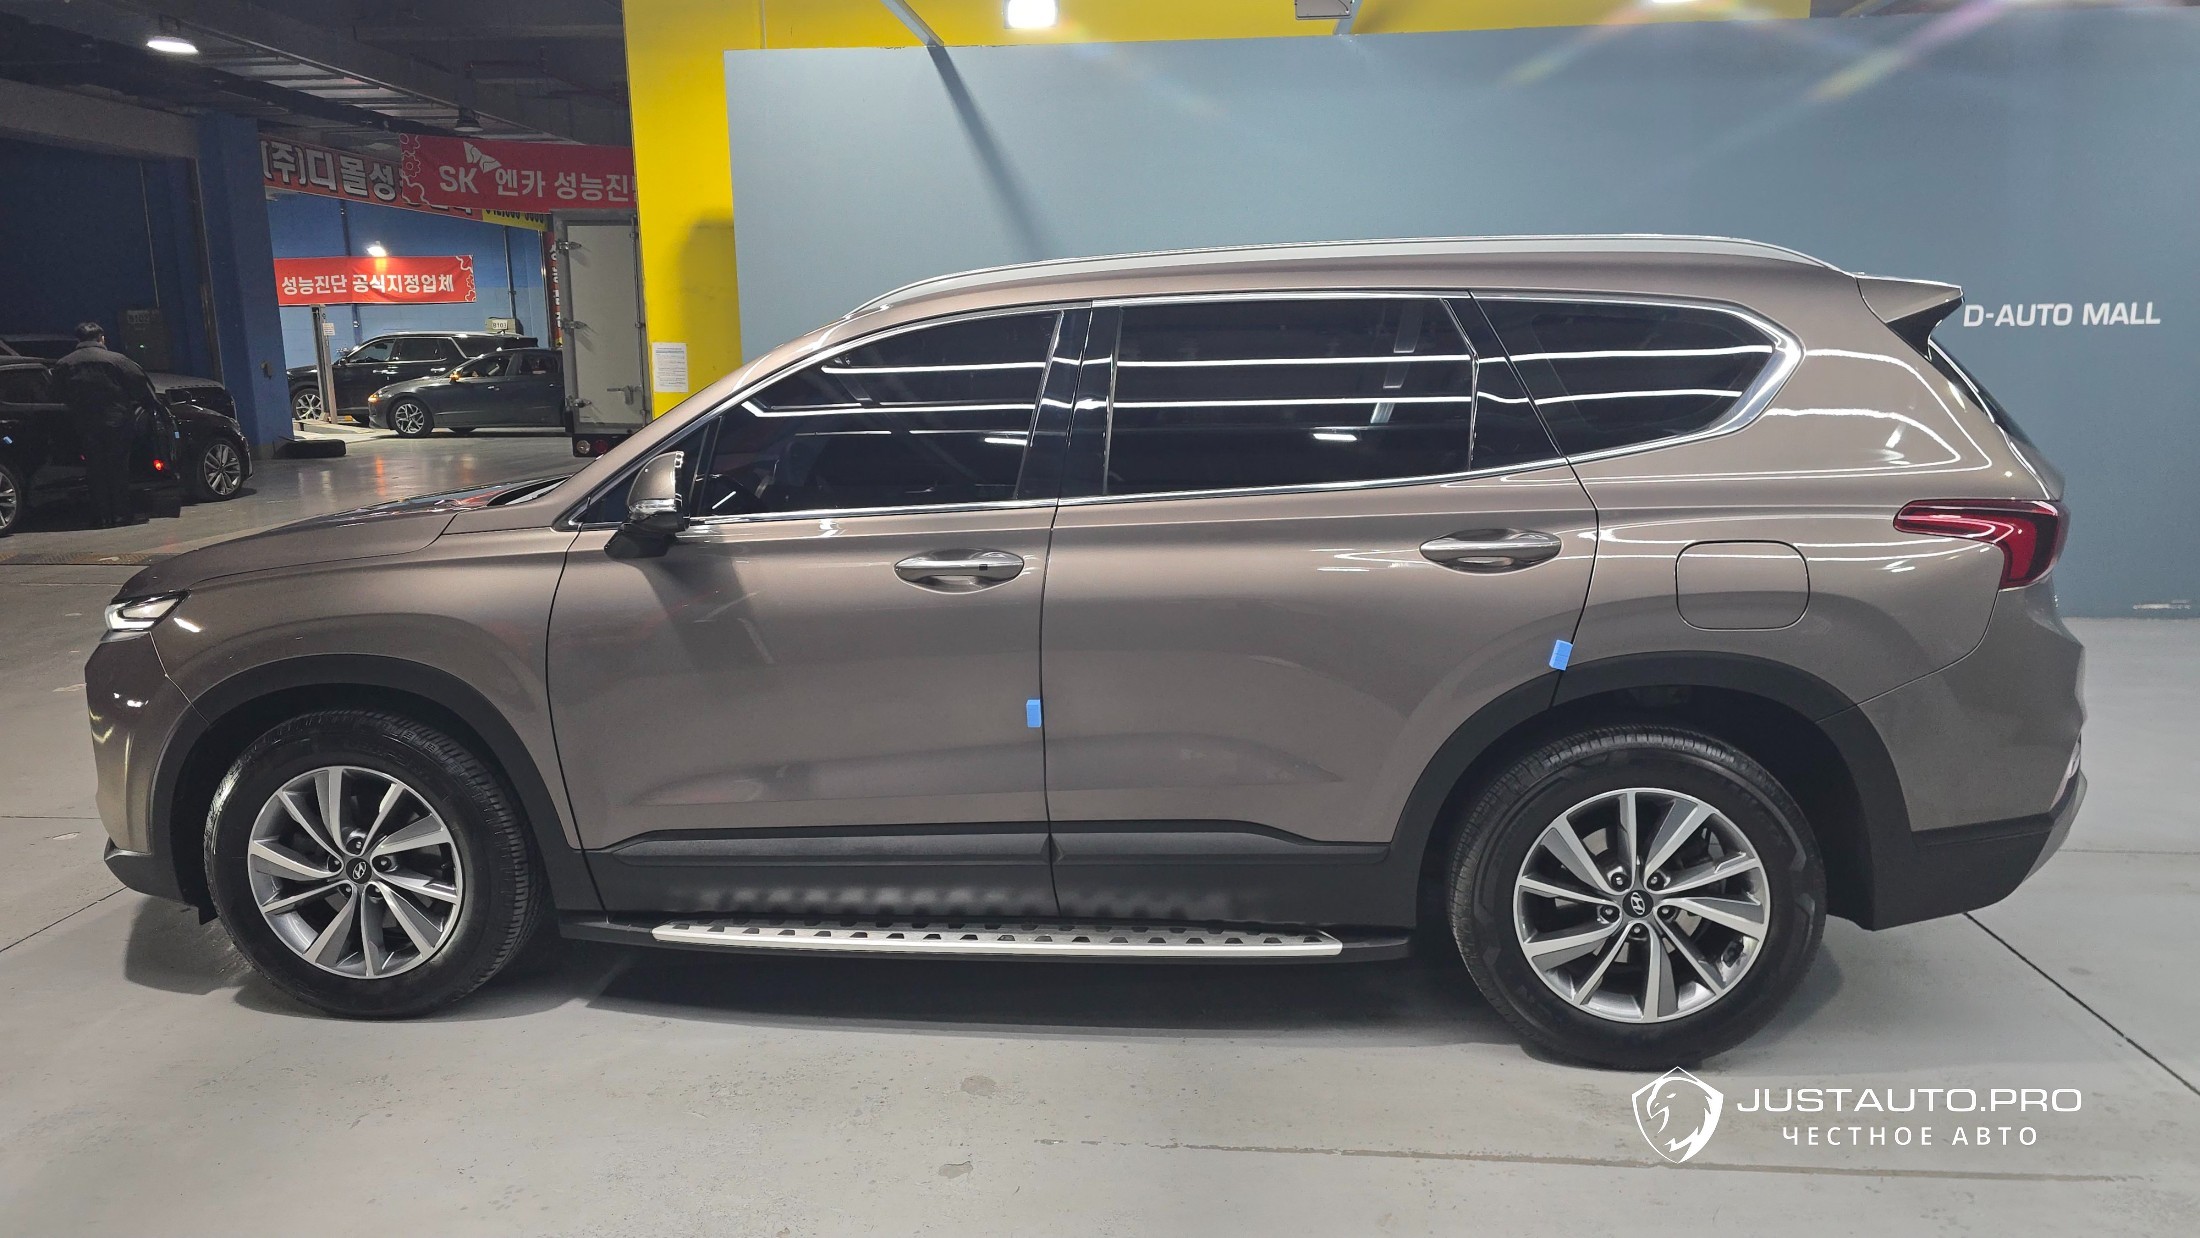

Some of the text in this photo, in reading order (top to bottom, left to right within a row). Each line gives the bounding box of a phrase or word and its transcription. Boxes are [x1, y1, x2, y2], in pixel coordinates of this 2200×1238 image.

[260, 140, 400, 200] (주)디몰성
[438, 165, 637, 202] SK 엔카 성능진
[281, 274, 455, 295] 성능진단 공식지정업체
[1963, 301, 2161, 327] D-AUTO MALL
